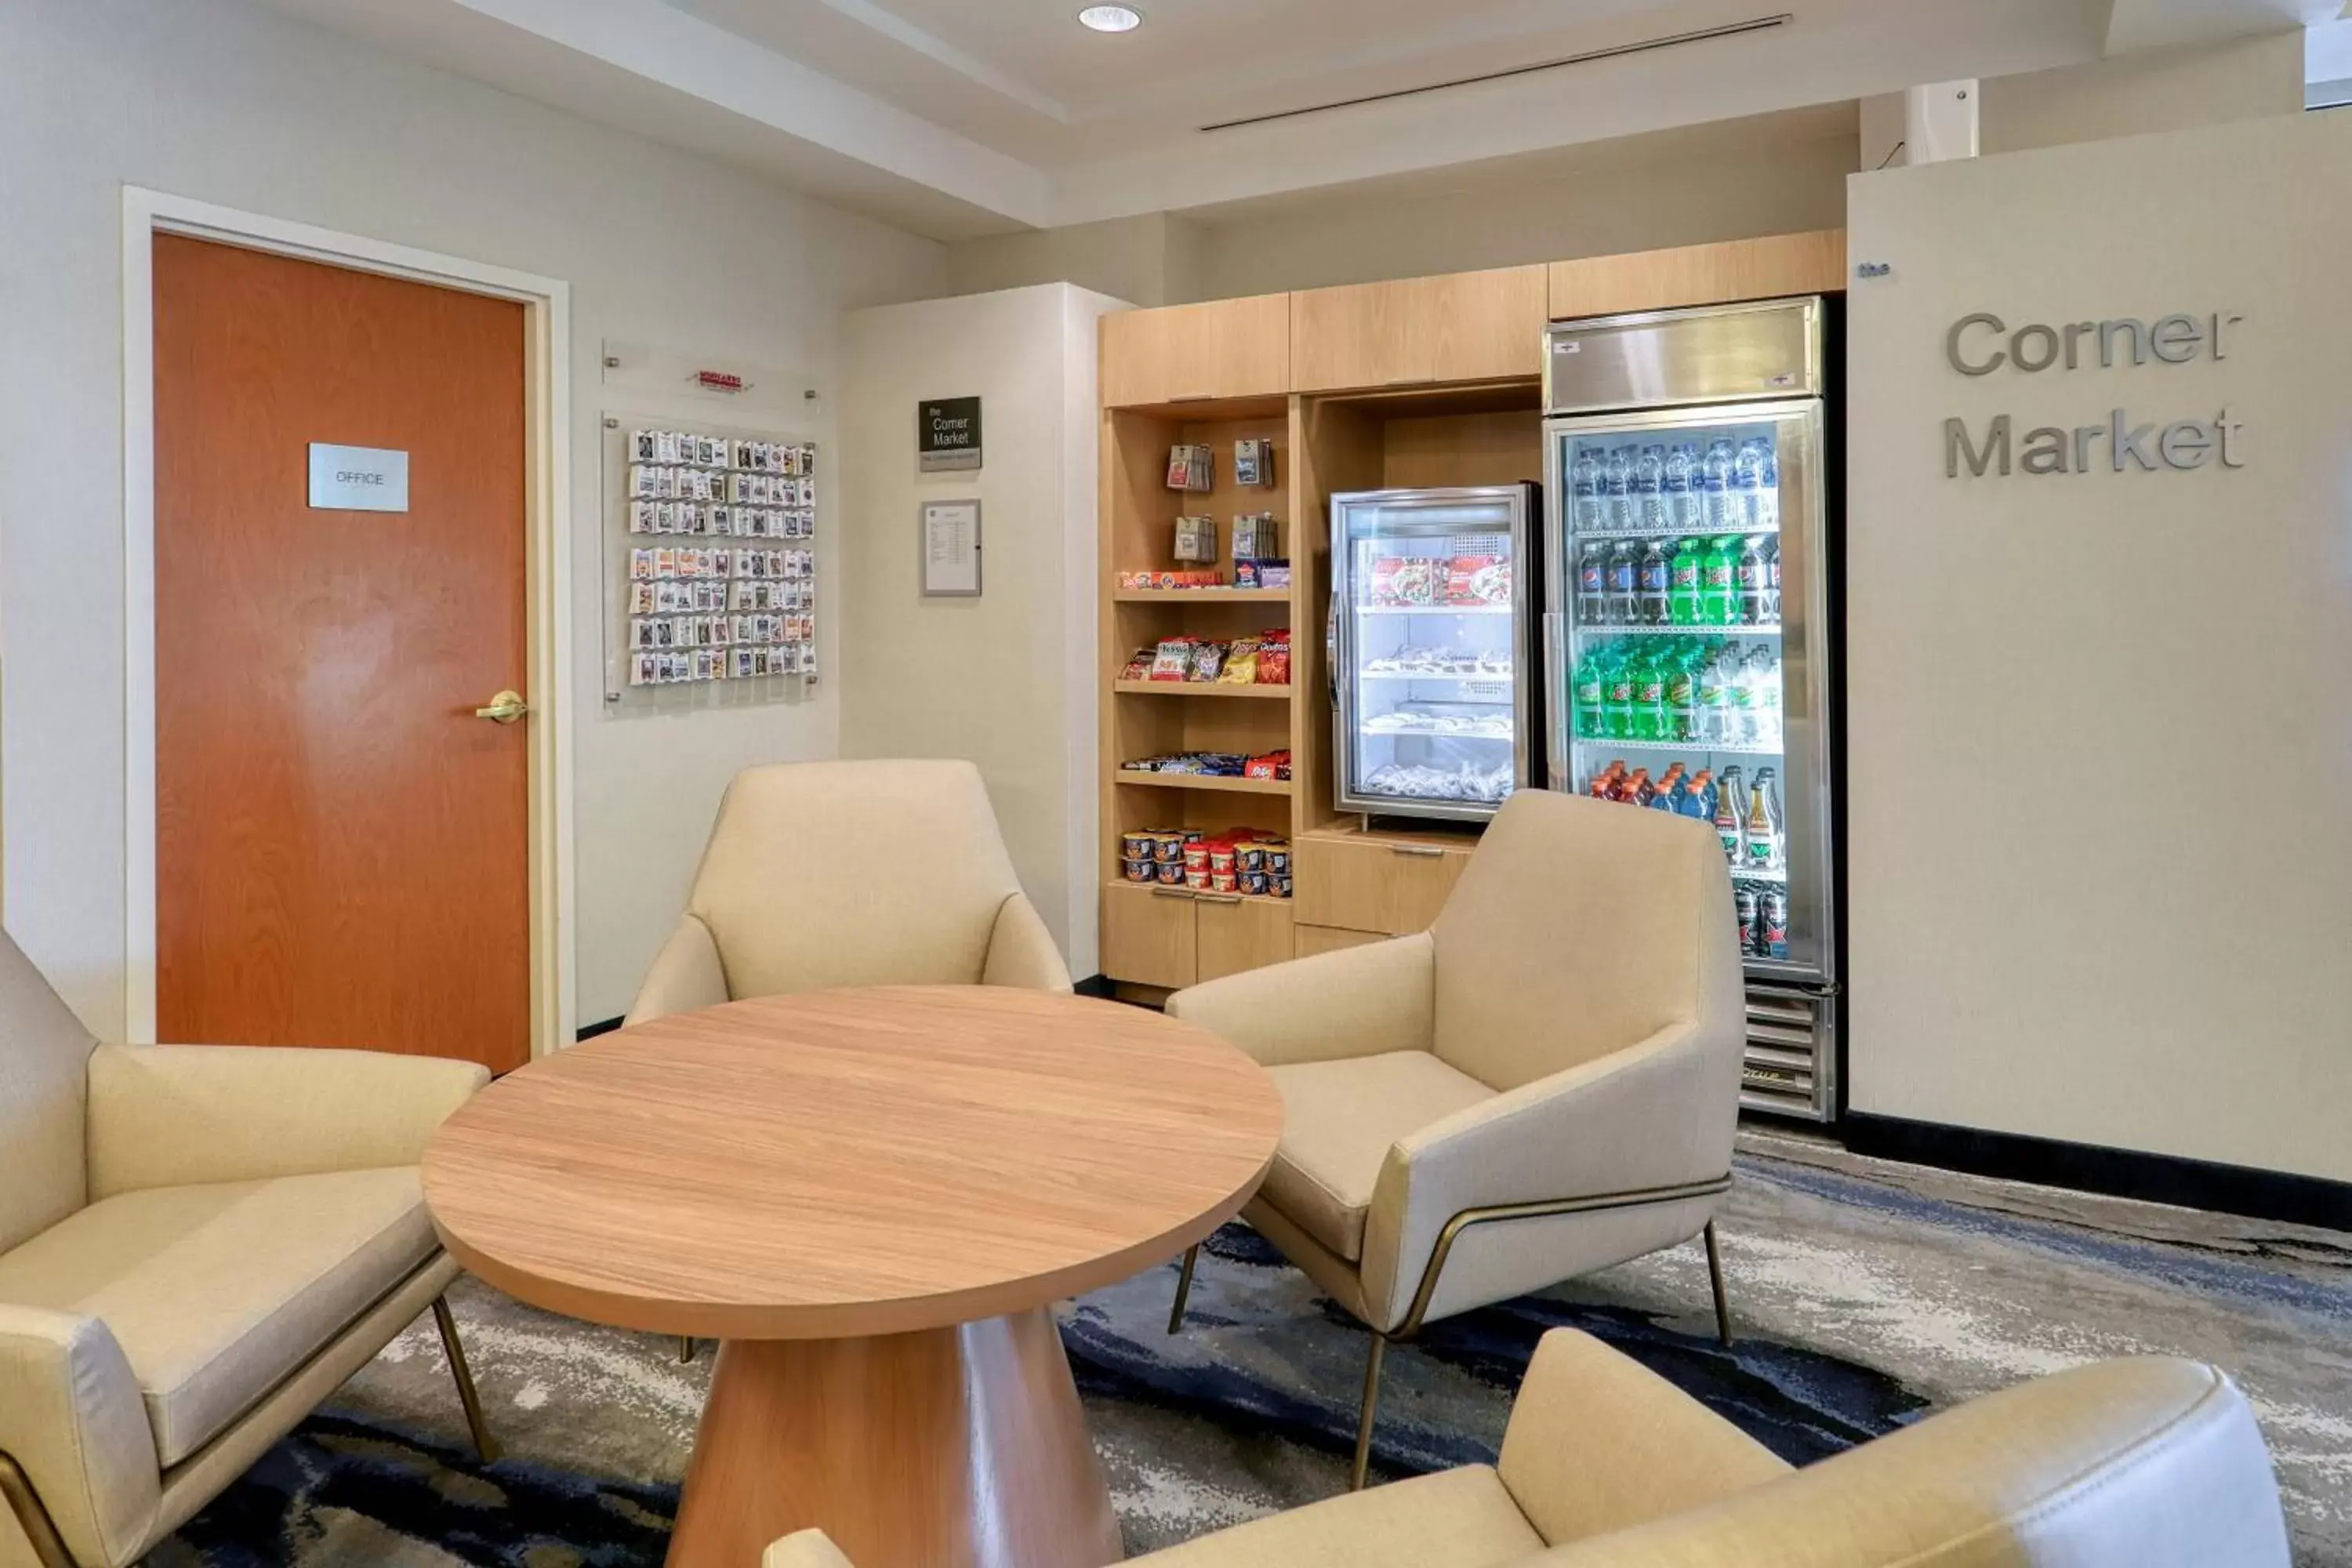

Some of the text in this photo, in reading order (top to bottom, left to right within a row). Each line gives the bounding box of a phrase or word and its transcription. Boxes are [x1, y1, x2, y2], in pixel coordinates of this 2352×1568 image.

[1947, 312, 2243, 376] Corner
[934, 418, 969, 430] Corner
[934, 432, 969, 446] Market
[1944, 403, 2245, 477] Market
[336, 471, 384, 485] OFFICE
